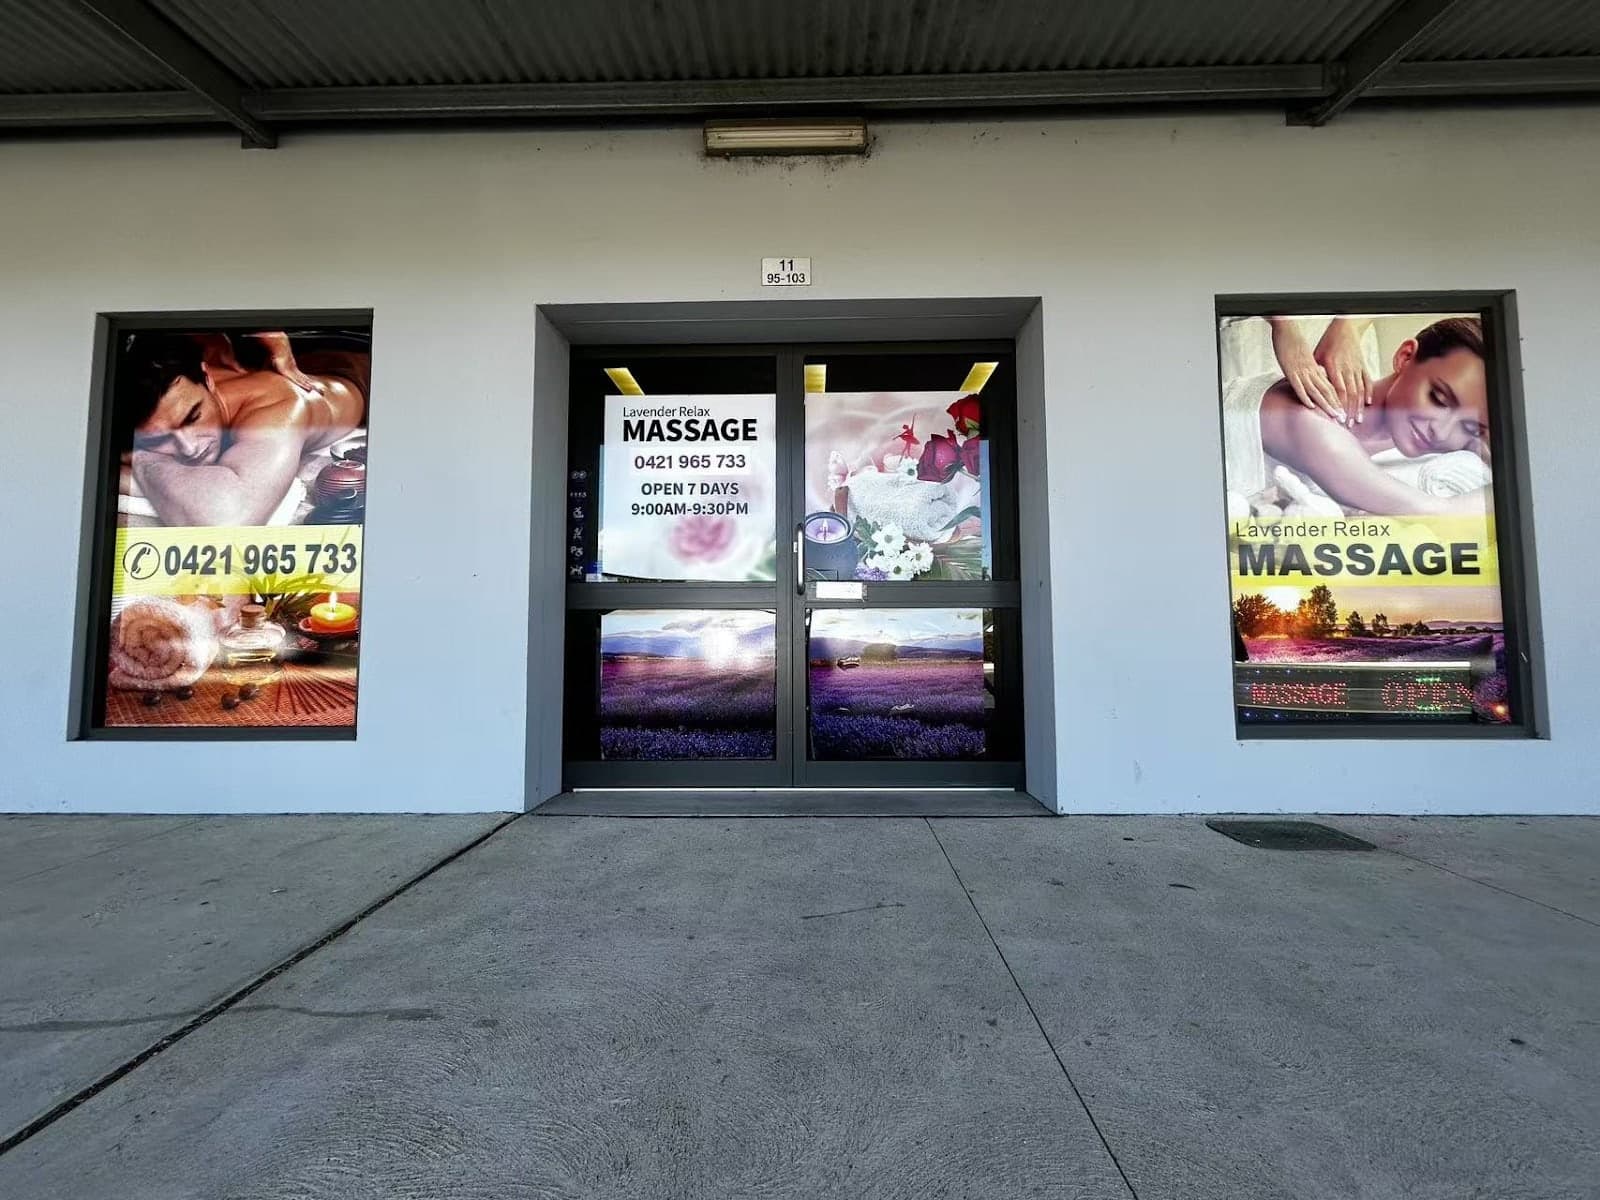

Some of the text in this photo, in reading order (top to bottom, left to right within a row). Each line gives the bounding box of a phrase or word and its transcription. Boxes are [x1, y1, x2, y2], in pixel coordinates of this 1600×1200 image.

[779, 259, 793, 271] 11
[767, 273, 805, 283] 95-103
[623, 406, 710, 417] Lavender Relax
[623, 418, 757, 442] MASSAGE
[634, 454, 746, 469] 0421 965 733
[641, 482, 739, 495] OPEN 7 DAYS
[631, 502, 749, 515] 9:00AM-9:30PM
[1236, 521, 1391, 537] Lavender Relax
[164, 543, 357, 575] 0421 965 733
[1238, 543, 1480, 576] MASSAGE
[1250, 683, 1346, 705] MASSAGE
